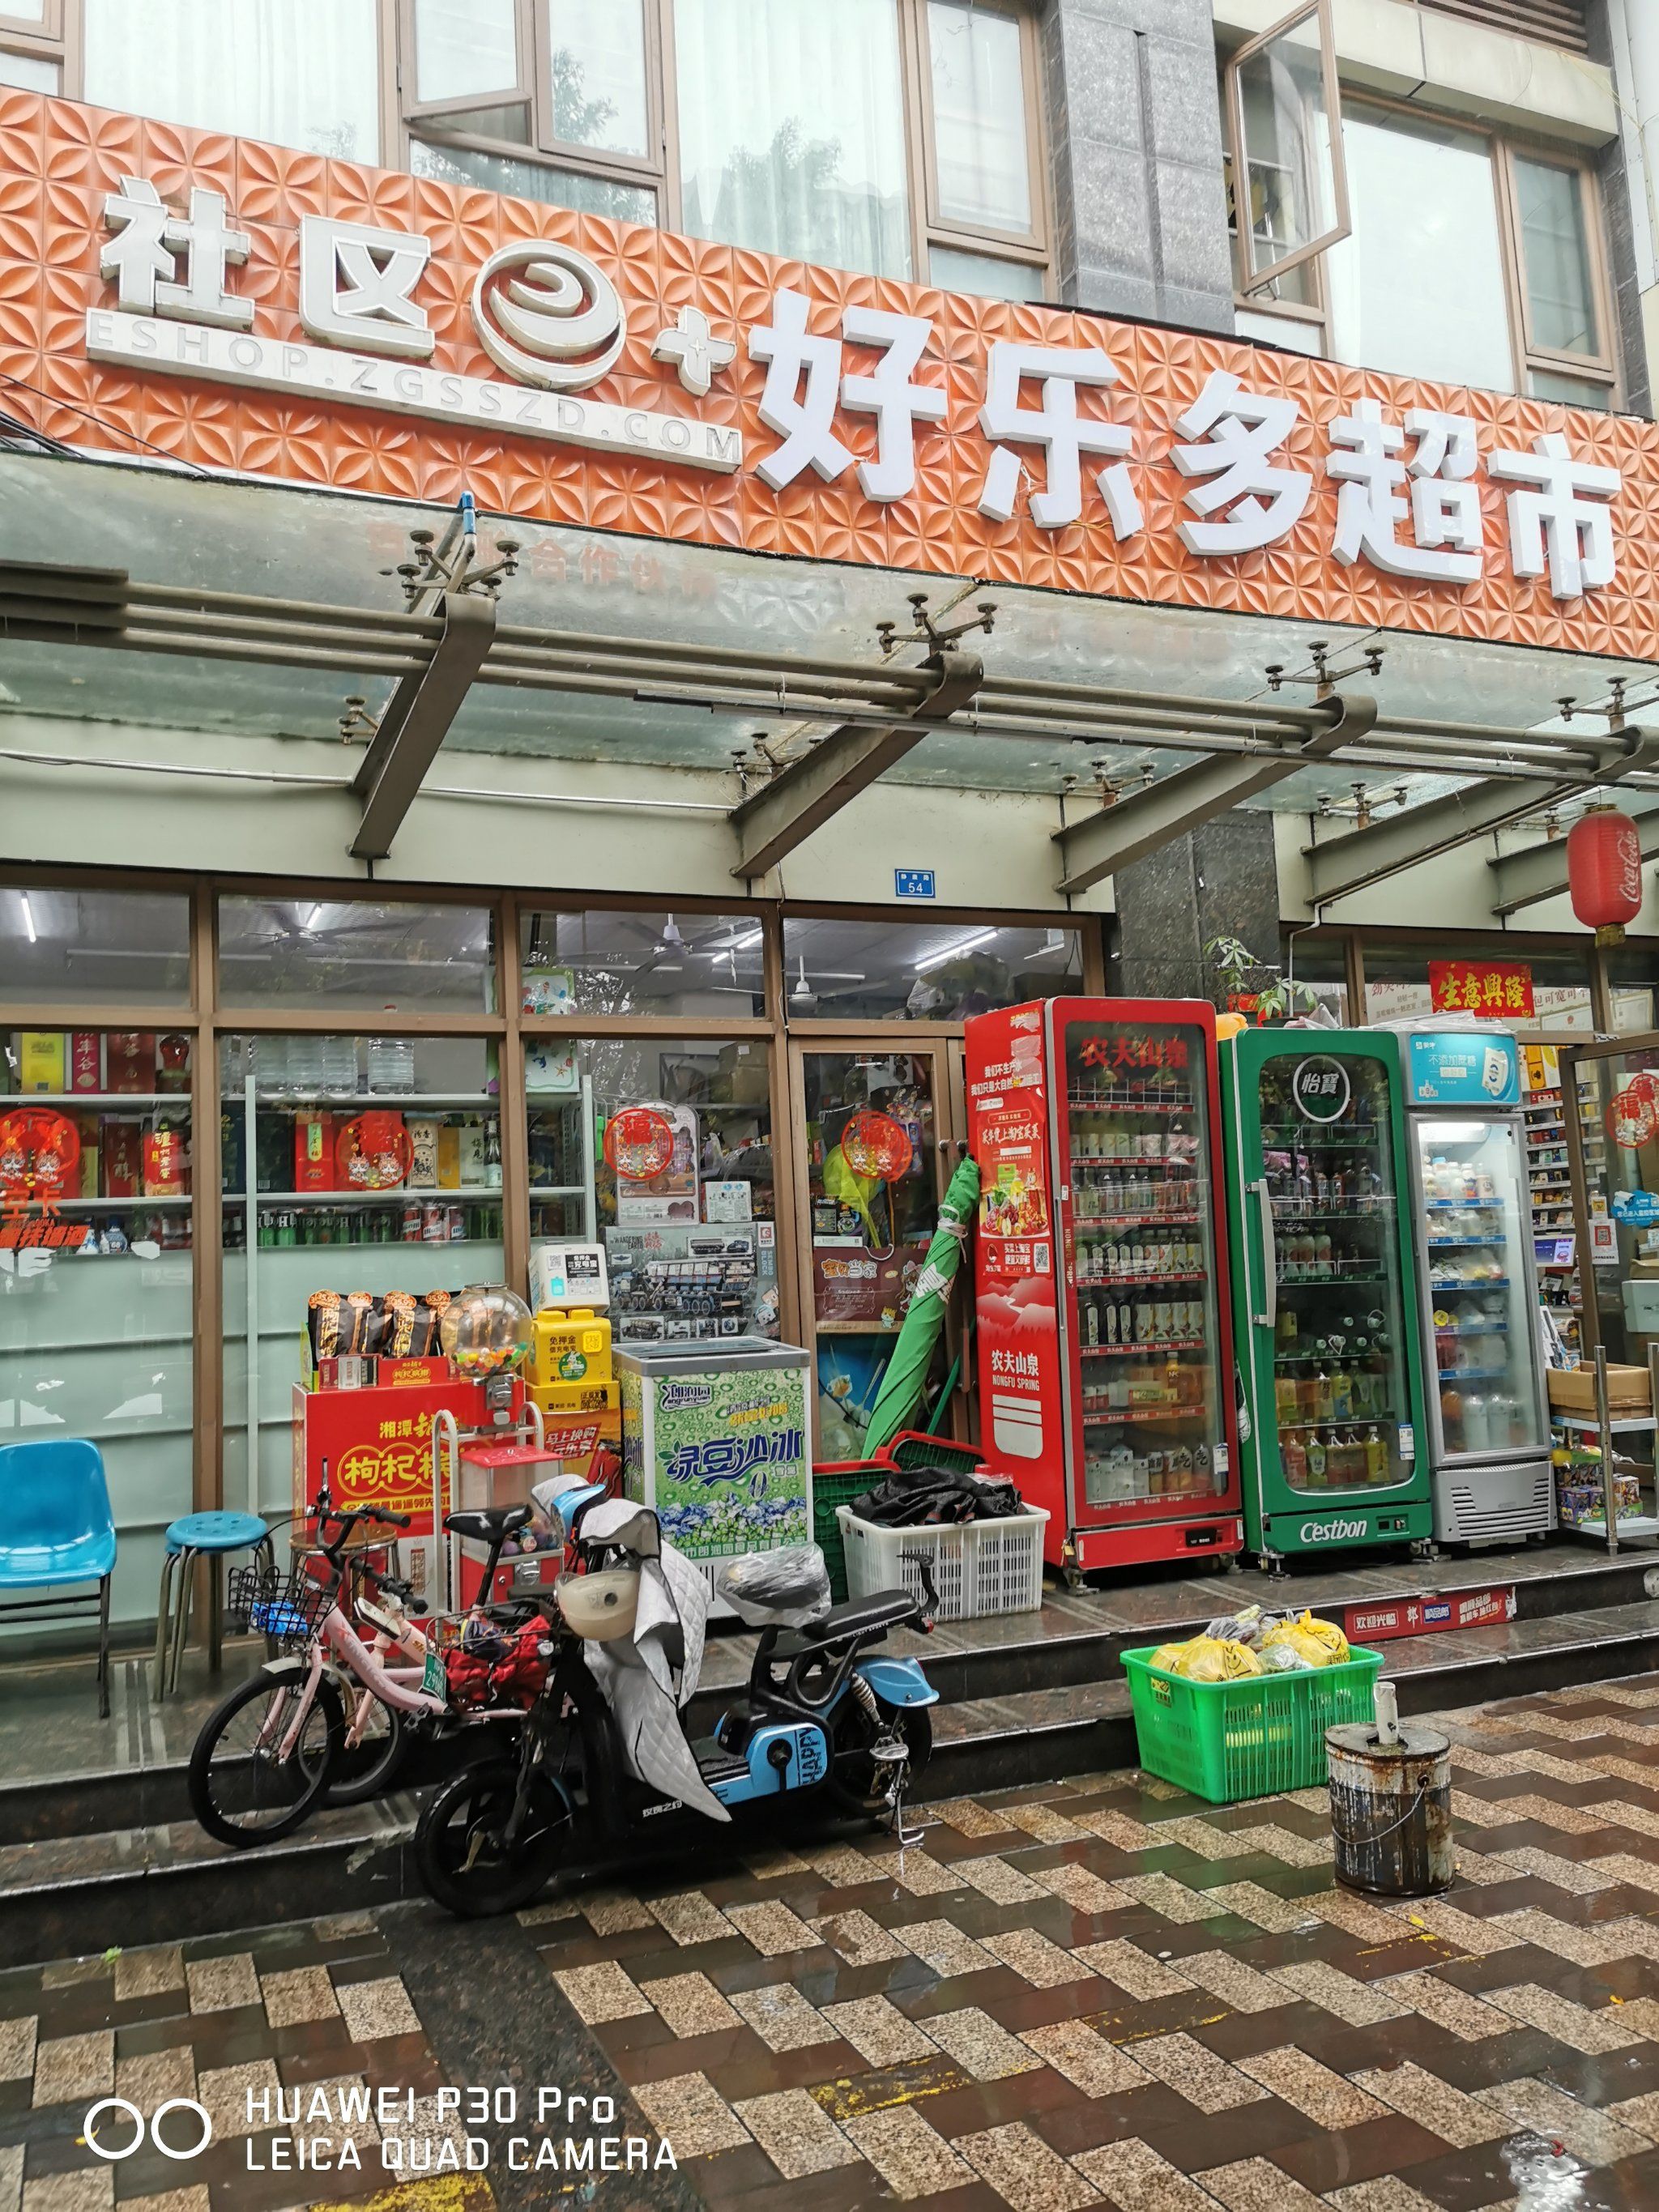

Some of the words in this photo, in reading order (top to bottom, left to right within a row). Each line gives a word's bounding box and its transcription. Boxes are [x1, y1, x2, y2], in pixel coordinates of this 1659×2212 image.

[99, 175, 437, 360] 社区
[87, 308, 742, 465] ESHOP.ZGSSZD.COM
[747, 287, 1622, 600] 好乐多超市
[908, 882, 923, 893] 54
[1078, 1035, 1189, 1069] 农夫山泉
[549, 1335, 577, 1345] 免押金
[992, 1349, 1040, 1377] 农夫山泉
[992, 1374, 1016, 1389] NONGFU
[1017, 1377, 1041, 1392] SPRING
[1356, 1612, 1397, 1630] 欢迎光临
[1407, 1605, 1418, 1629] 郎
